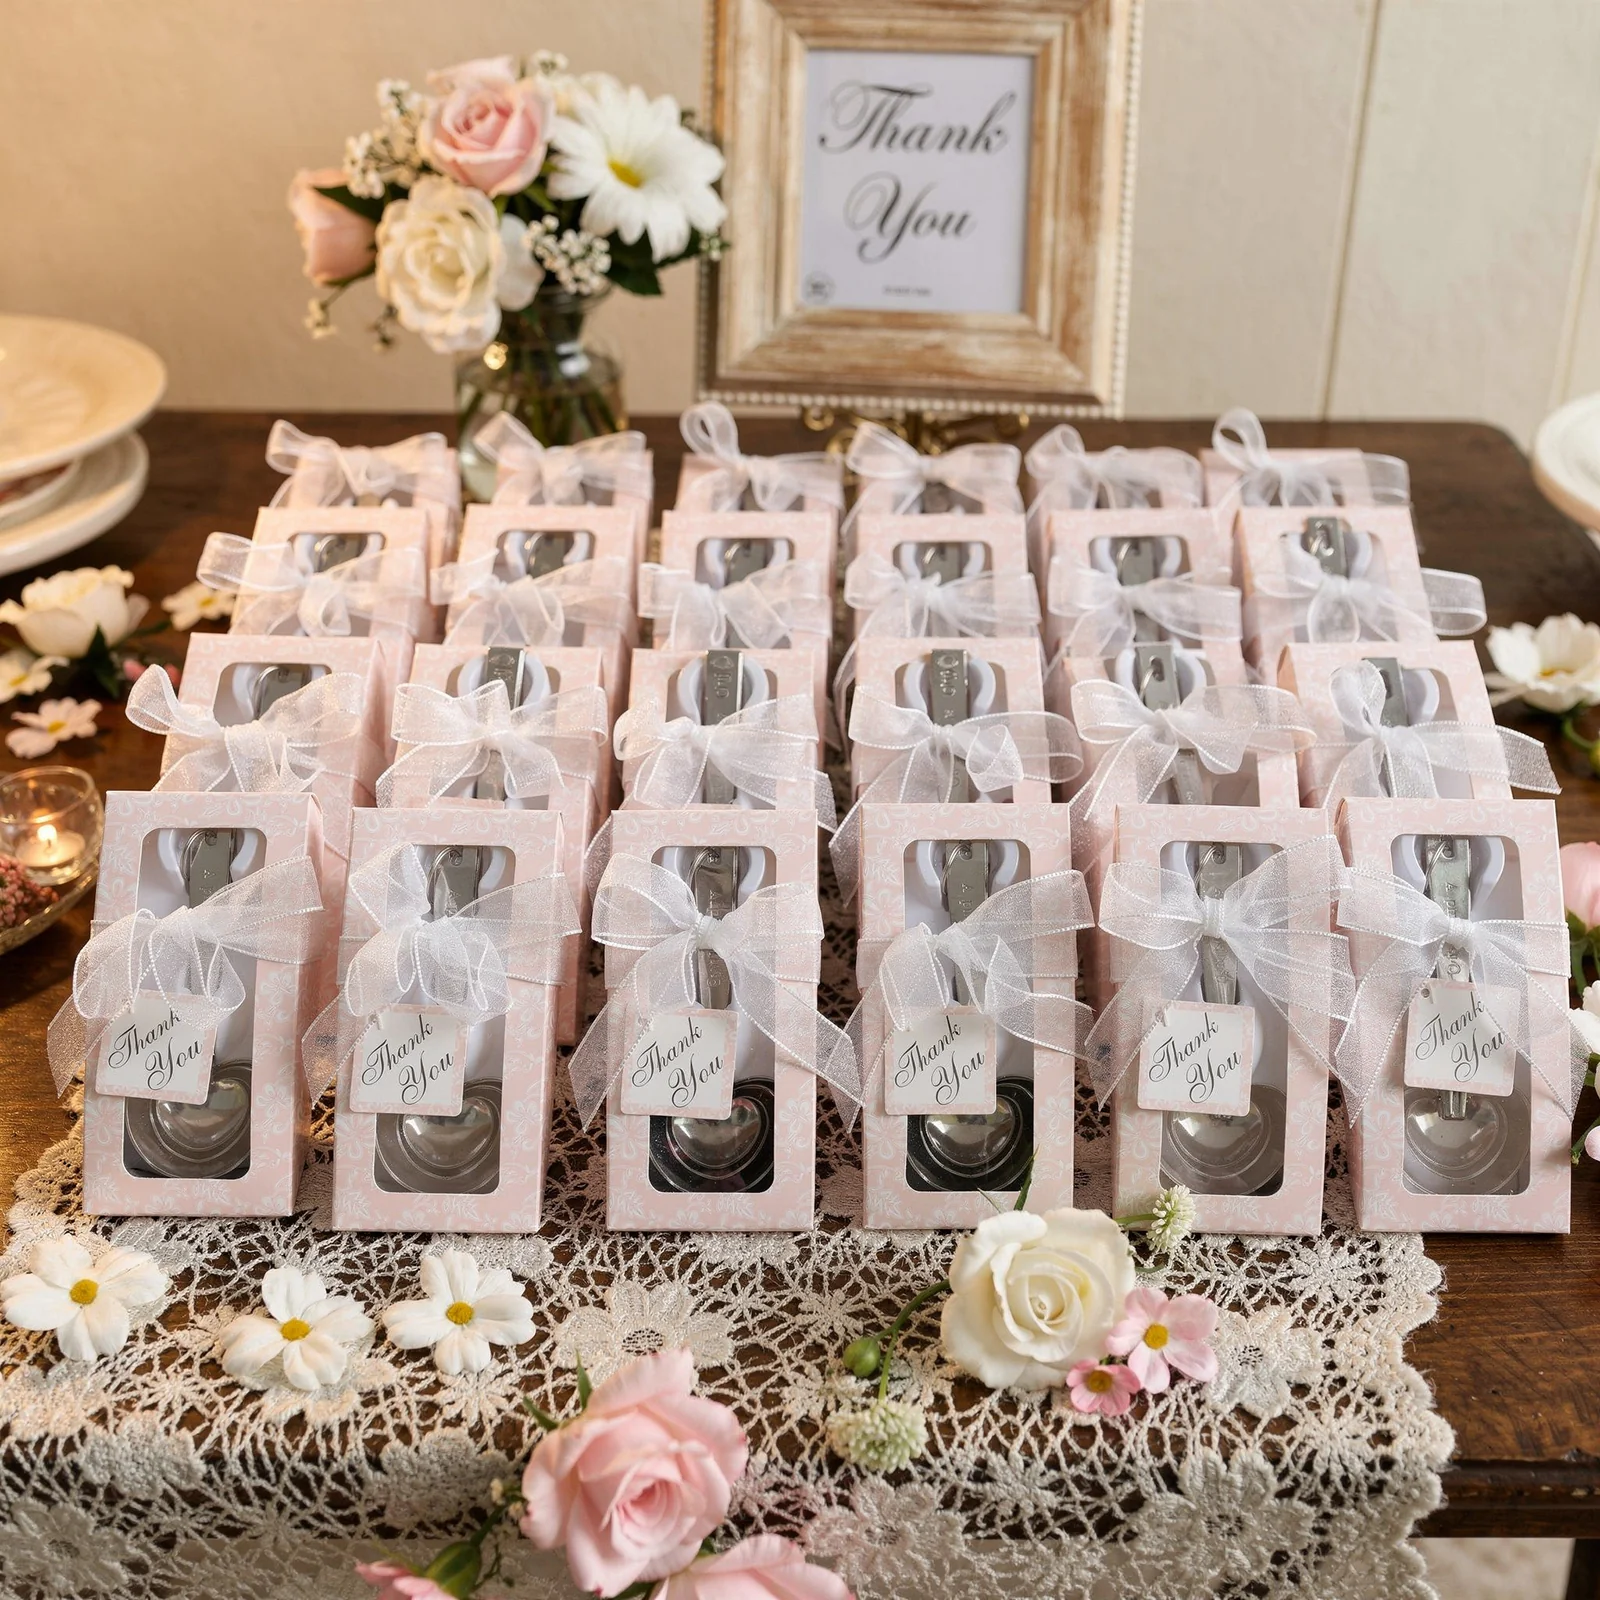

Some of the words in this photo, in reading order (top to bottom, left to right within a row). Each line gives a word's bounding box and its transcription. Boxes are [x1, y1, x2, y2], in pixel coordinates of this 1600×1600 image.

[817, 79, 1018, 155] Thank
[843, 170, 978, 265] You
[108, 1007, 181, 1069] Thank
[362, 1013, 434, 1086] Thank
[632, 1016, 703, 1087] Thank
[894, 1014, 962, 1088] Thank
[1147, 1011, 1220, 1084] Thank
[1415, 990, 1485, 1061] Thank
[1451, 1027, 1506, 1083] You
[145, 1036, 202, 1091] You
[400, 1050, 455, 1106] You
[667, 1052, 723, 1109] You
[932, 1050, 986, 1106] You
[1185, 1048, 1242, 1104] You
